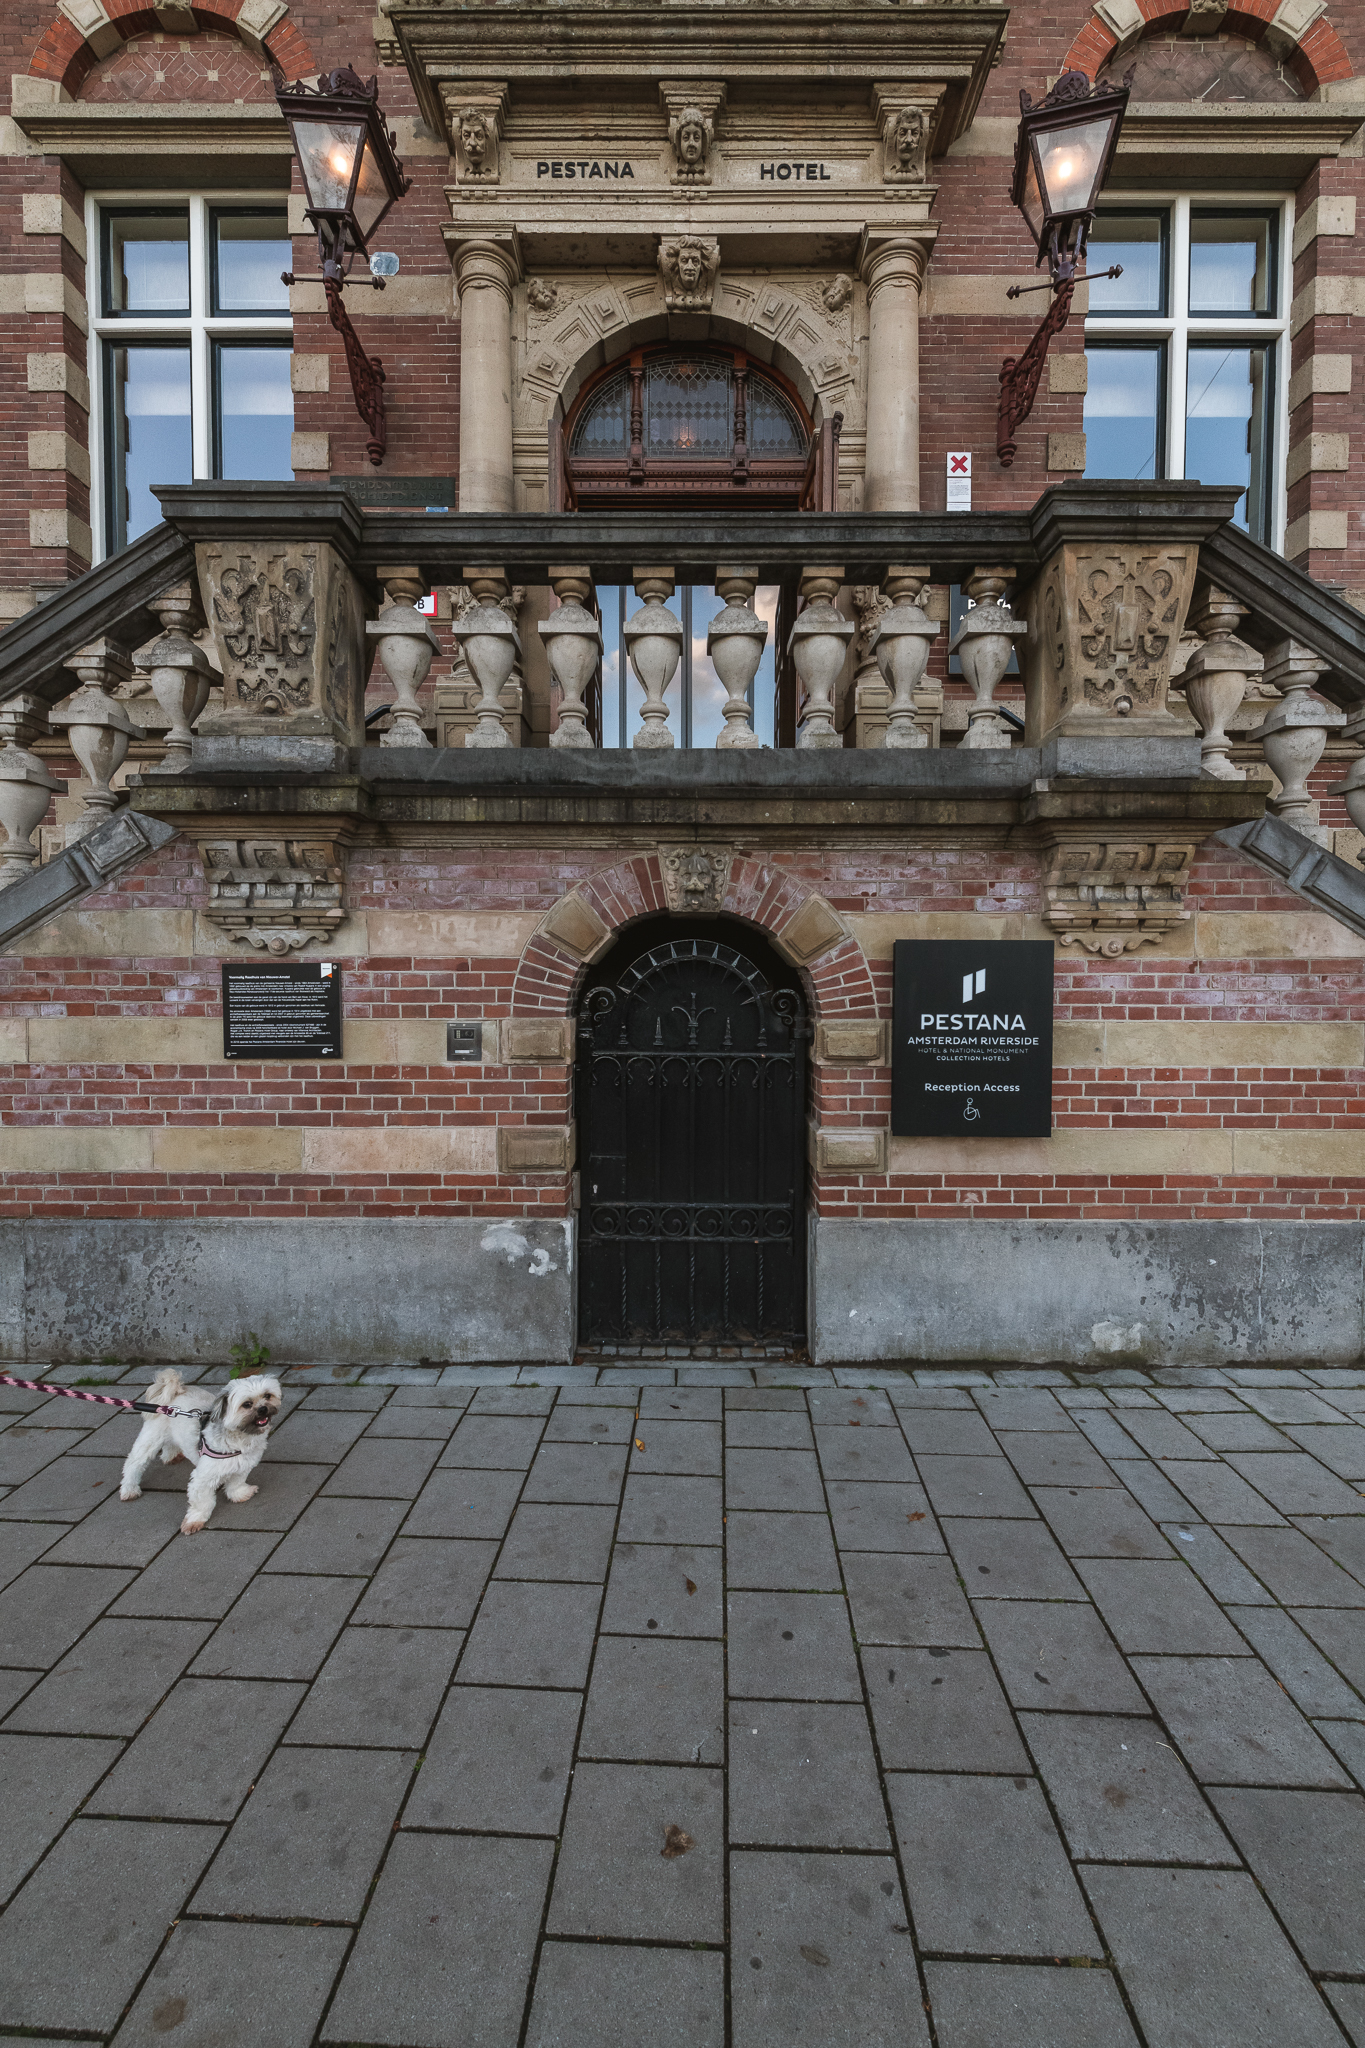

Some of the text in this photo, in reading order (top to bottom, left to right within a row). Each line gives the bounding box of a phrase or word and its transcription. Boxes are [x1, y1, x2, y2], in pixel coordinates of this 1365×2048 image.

[537, 161, 635, 179] PESTANA
[760, 163, 831, 180] HOTEL
[350, 491, 444, 501] RCHIEFDIENST
[920, 1013, 1026, 1031] PESTANA
[907, 1036, 1040, 1046] AMSTERDAM RIVERSIDE
[924, 1082, 1020, 1093] Reception Access
